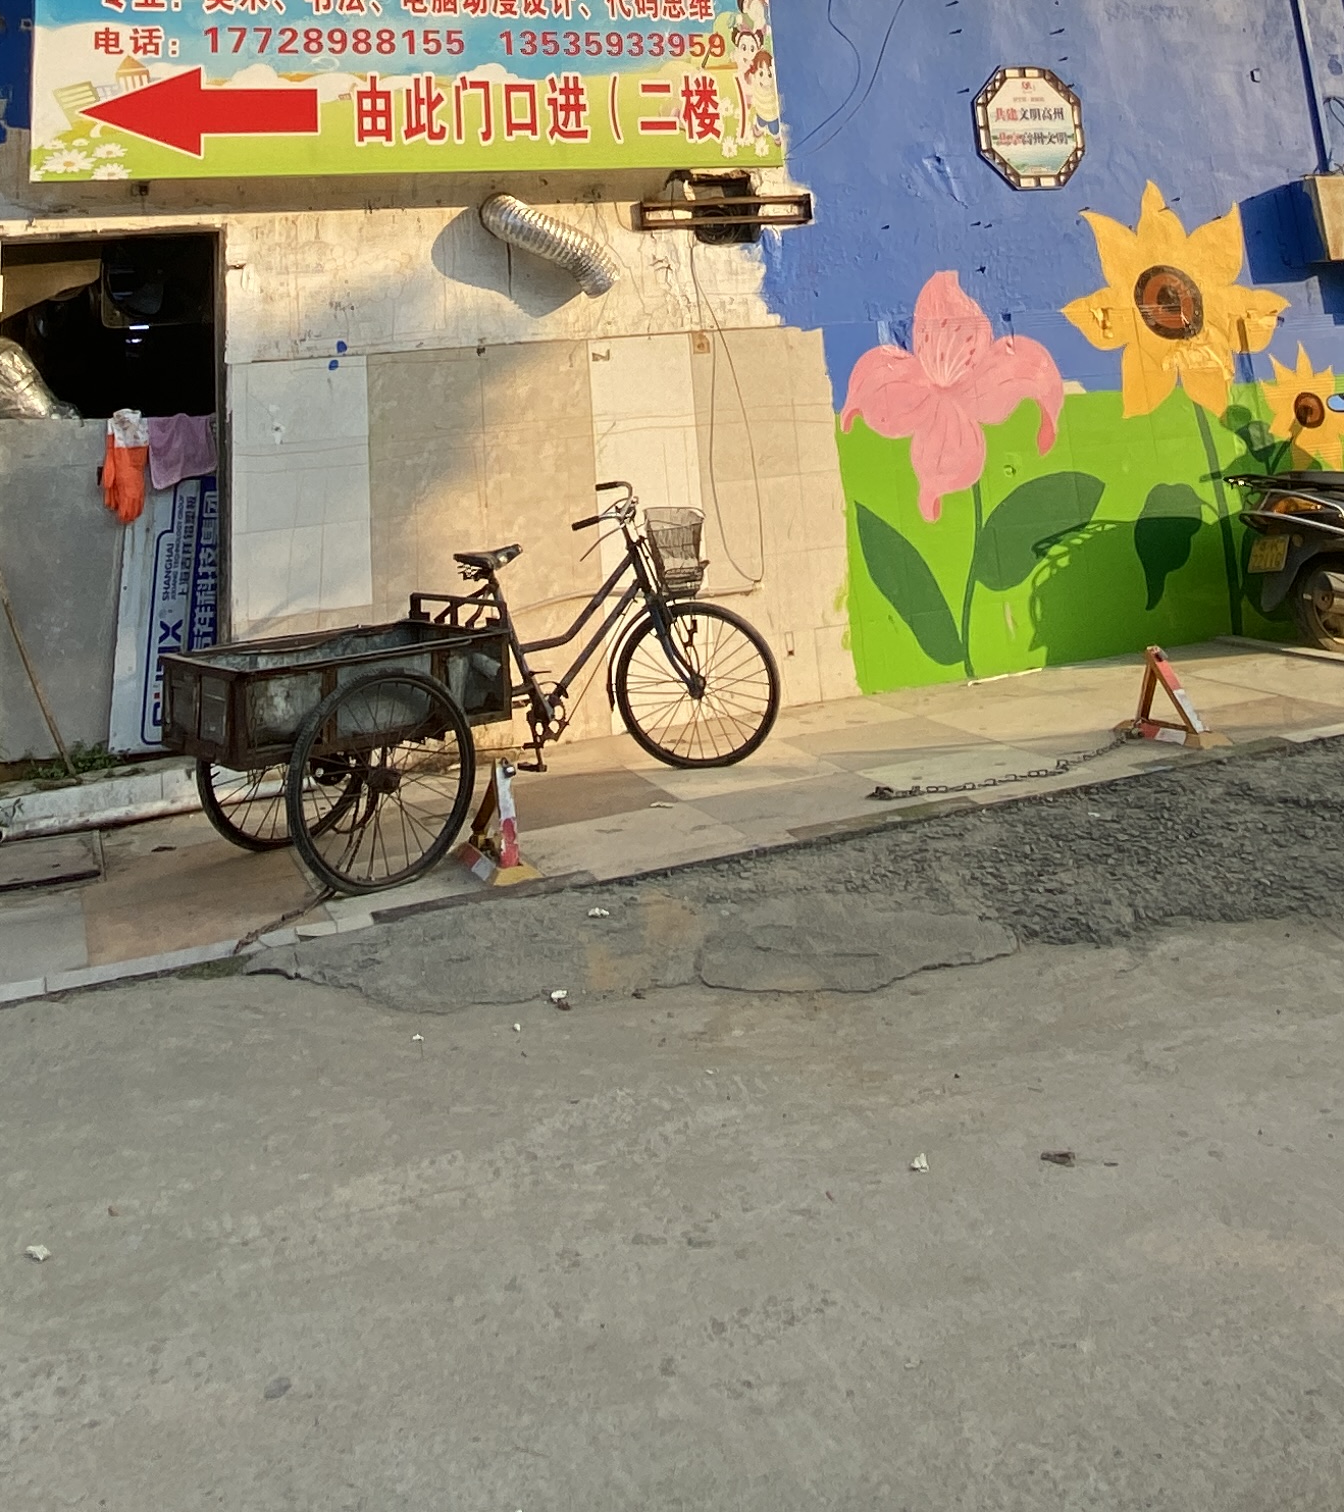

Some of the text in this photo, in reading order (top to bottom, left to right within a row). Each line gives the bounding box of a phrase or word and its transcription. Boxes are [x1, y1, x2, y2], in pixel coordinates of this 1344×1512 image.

[203, 26, 466, 57] 17728988155
[499, 28, 726, 58] 13535933959
[162, 543, 174, 601] SHANGHAI
